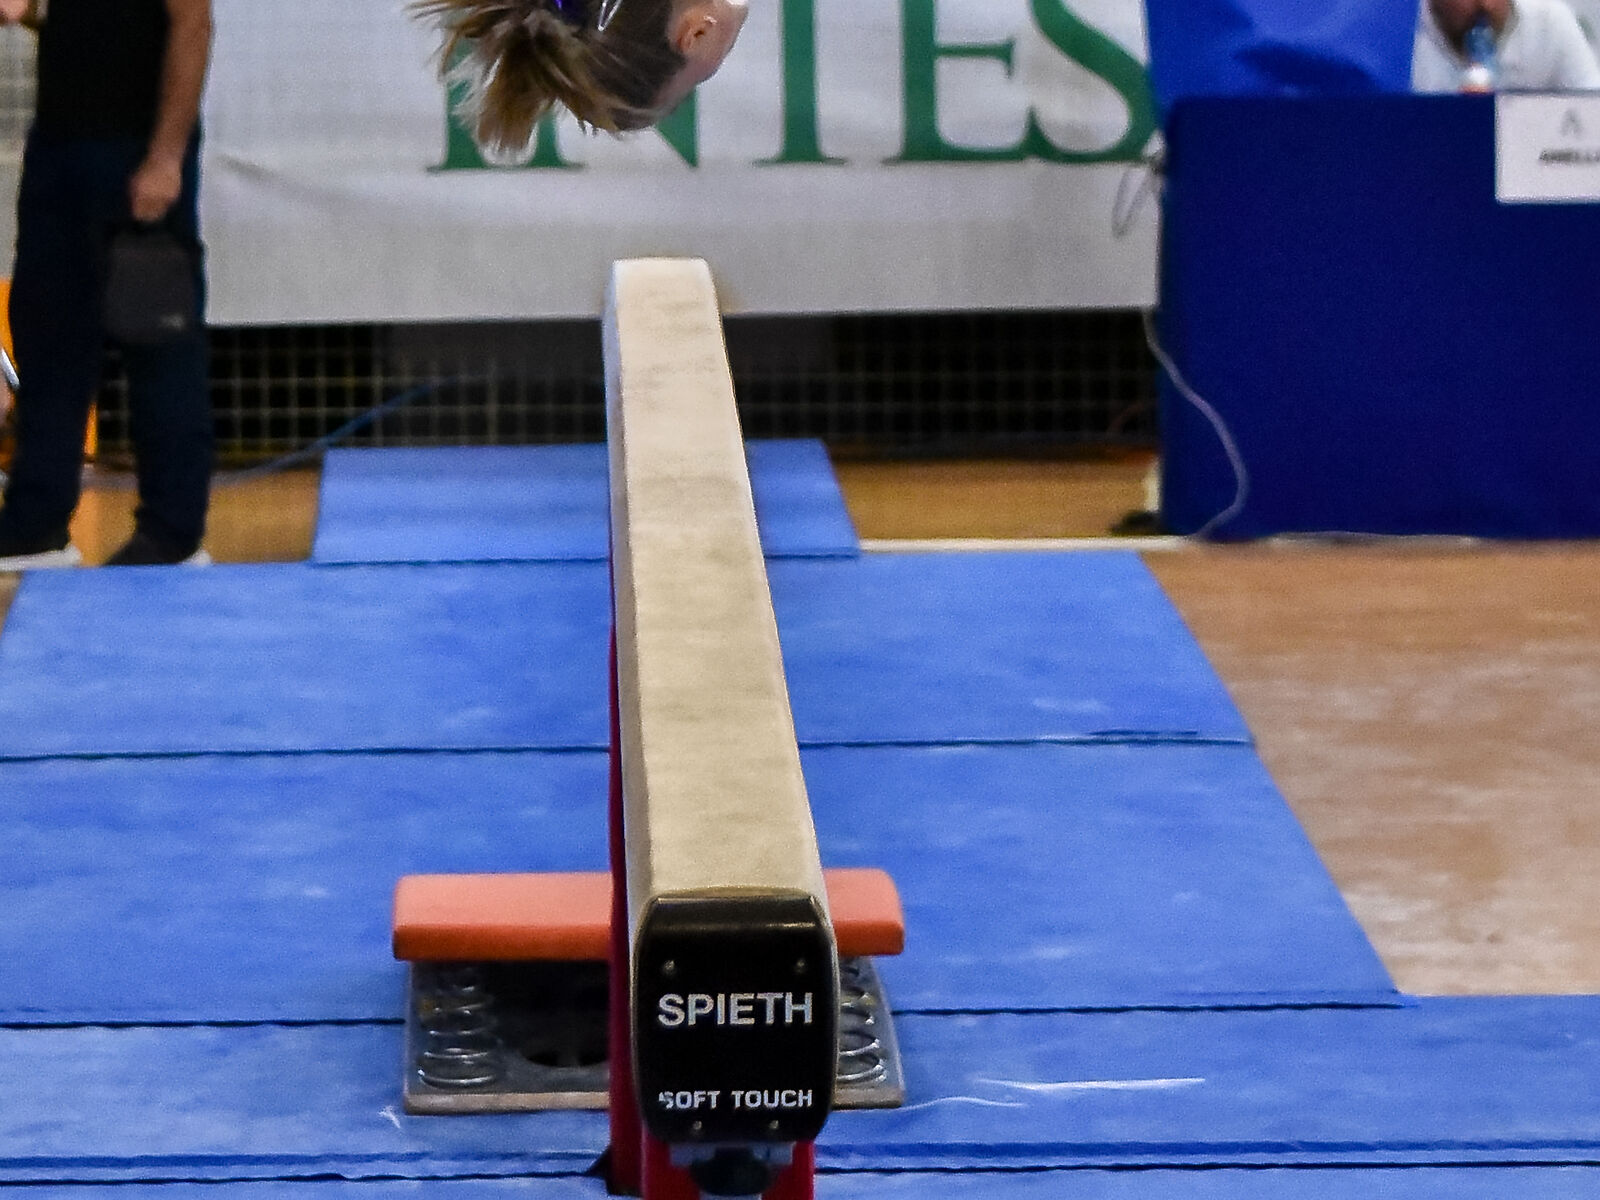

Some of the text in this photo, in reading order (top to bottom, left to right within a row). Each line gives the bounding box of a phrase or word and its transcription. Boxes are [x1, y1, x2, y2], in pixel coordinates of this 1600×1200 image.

[658, 992, 813, 1026] SPIETH
[658, 1089, 813, 1109] SOFT TOUCH
